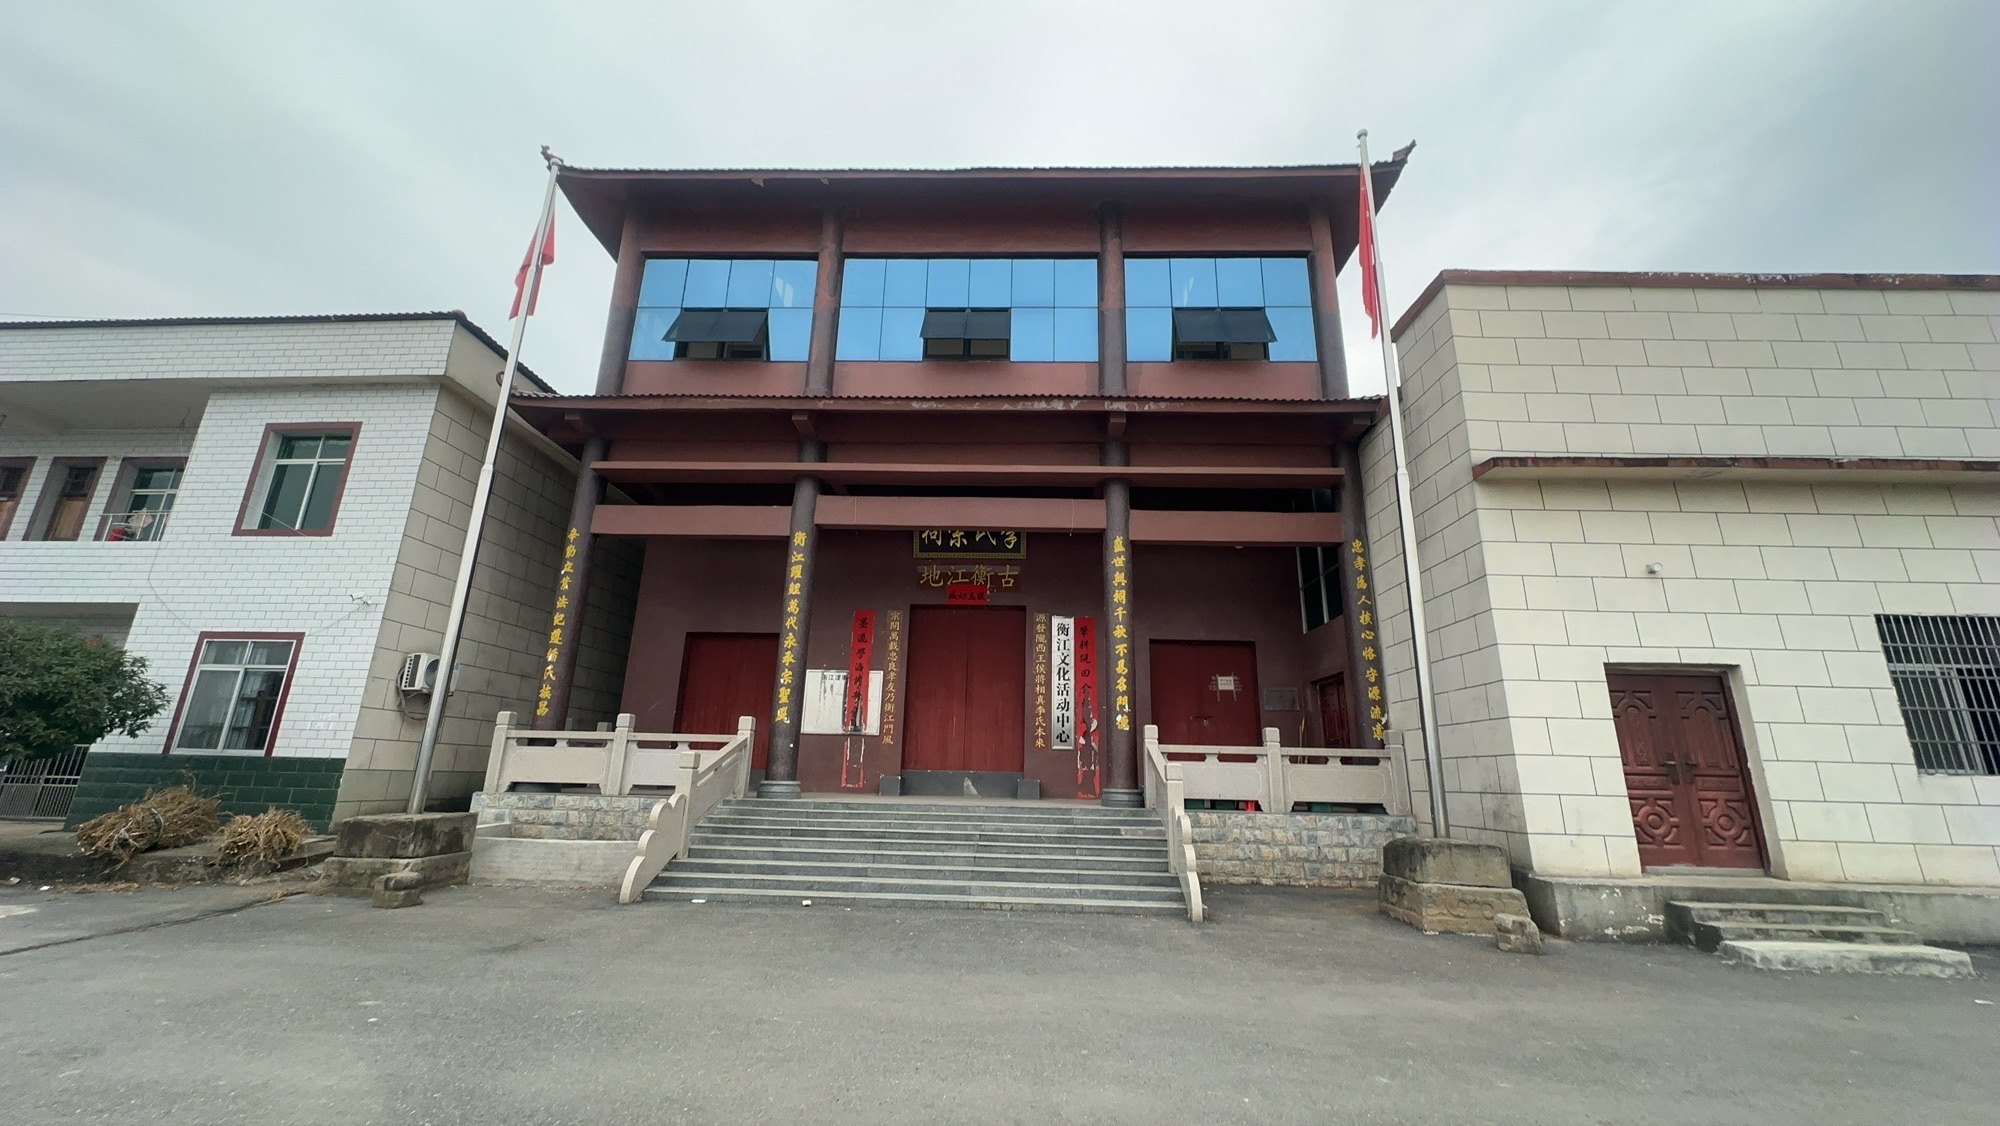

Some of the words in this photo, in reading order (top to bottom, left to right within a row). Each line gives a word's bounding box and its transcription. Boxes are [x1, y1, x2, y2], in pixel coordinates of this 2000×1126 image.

[1056, 622, 1071, 744] 衡江文化活动中心
